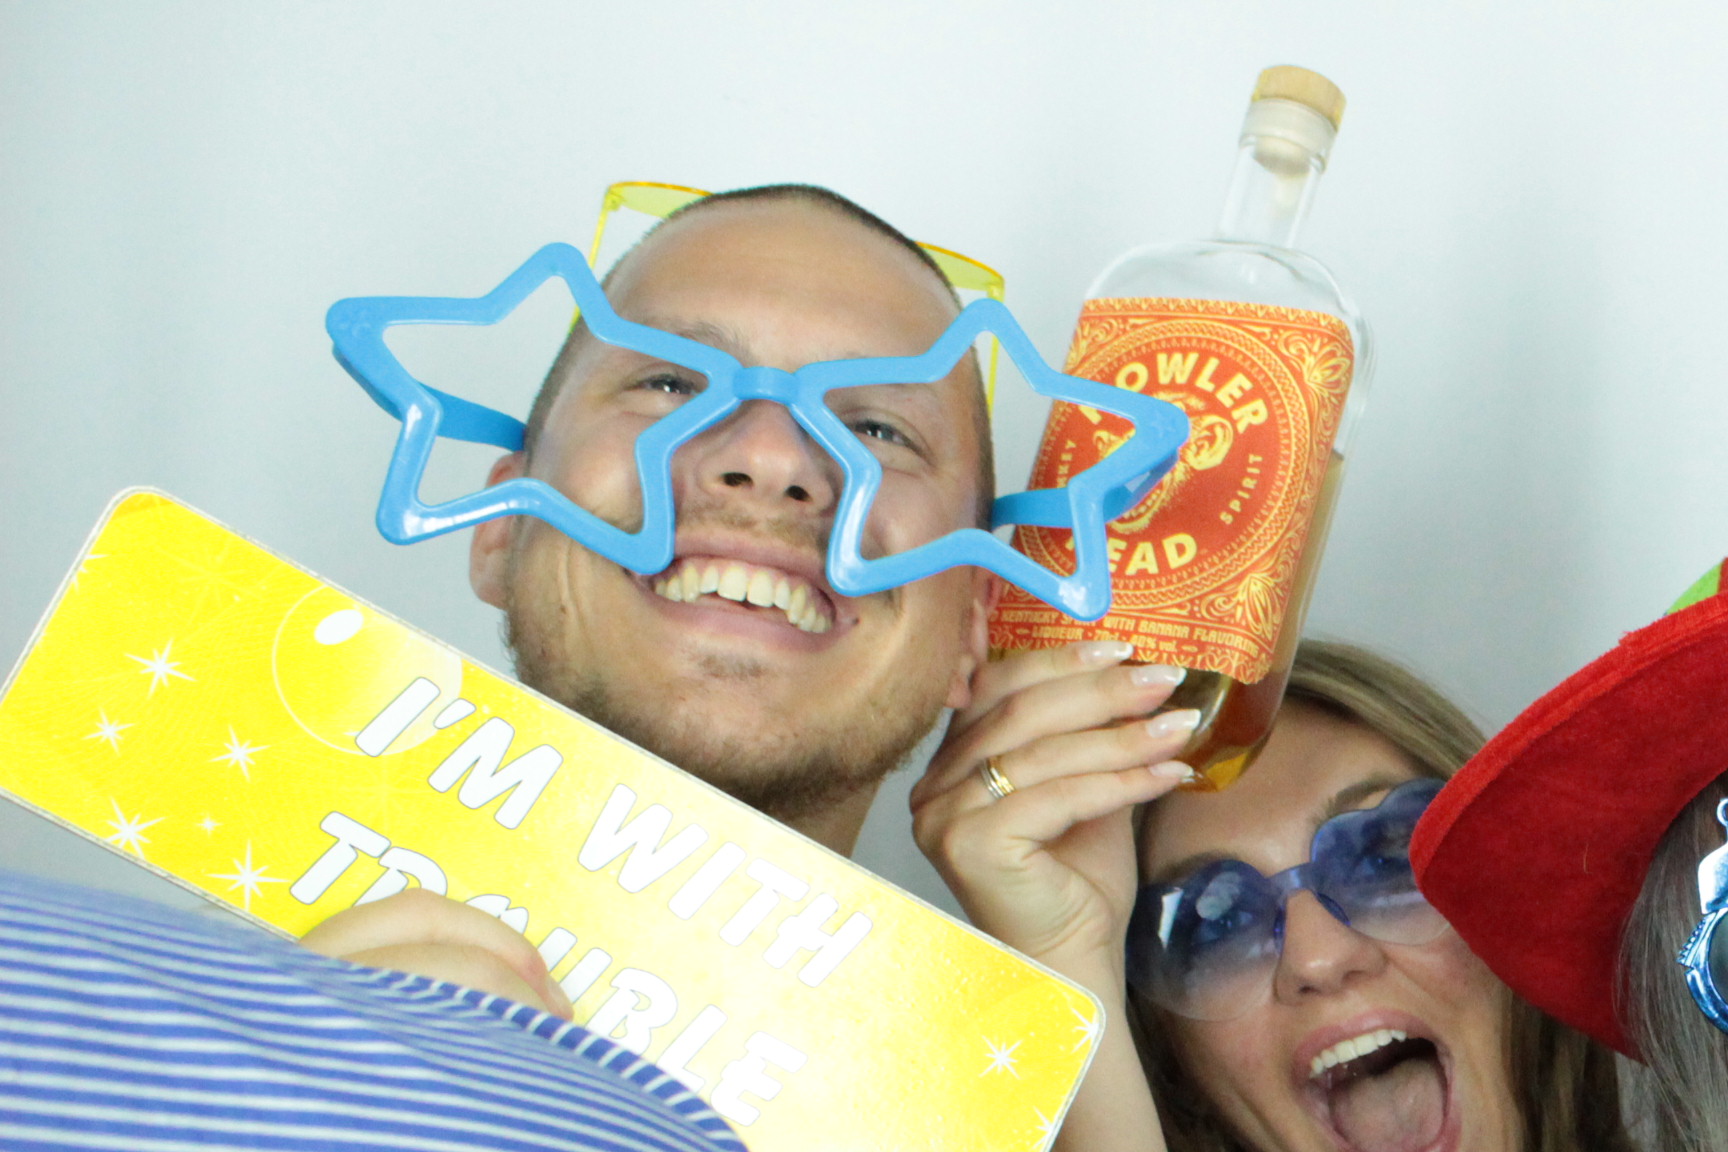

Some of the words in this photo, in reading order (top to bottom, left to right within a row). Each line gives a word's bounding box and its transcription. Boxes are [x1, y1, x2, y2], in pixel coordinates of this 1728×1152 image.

[1079, 352, 1268, 434] OWLER
[1219, 453, 1263, 525] SPIRIT
[1065, 532, 1197, 576] EAD
[1103, 615, 1136, 631] WITH
[1138, 619, 1190, 639] BANANA
[355, 677, 563, 830] I'M
[577, 783, 874, 988] WITH
